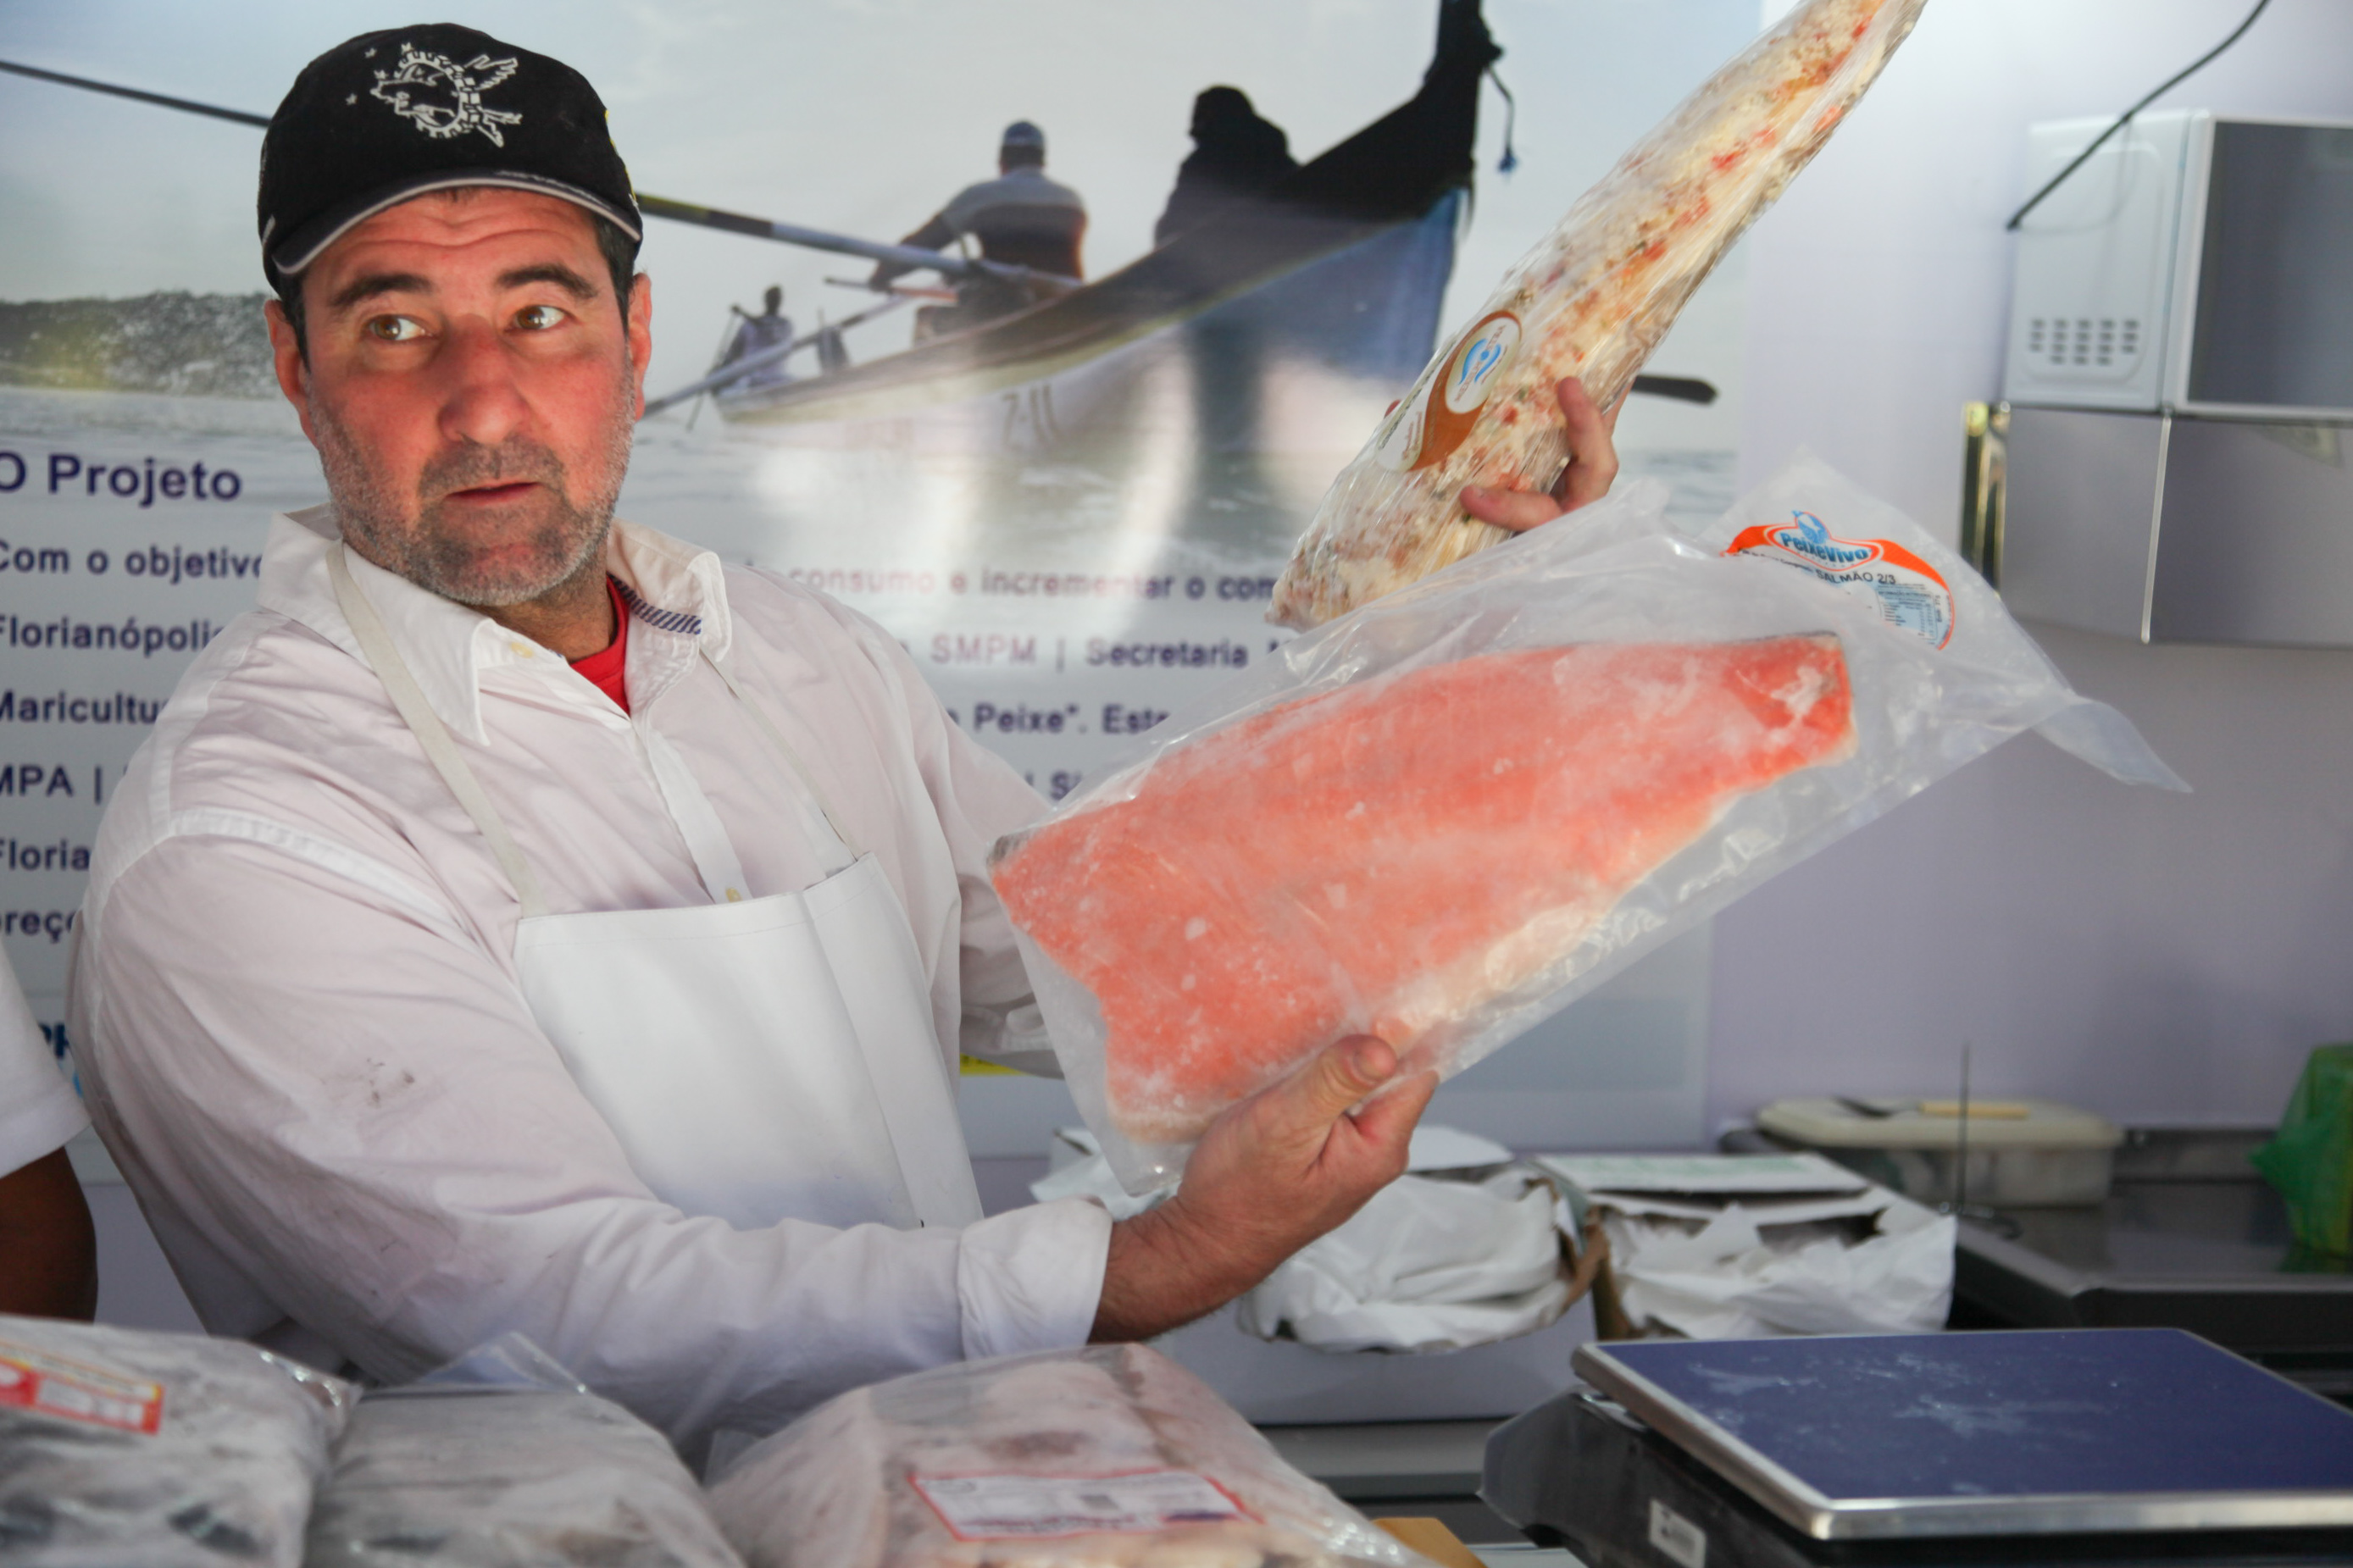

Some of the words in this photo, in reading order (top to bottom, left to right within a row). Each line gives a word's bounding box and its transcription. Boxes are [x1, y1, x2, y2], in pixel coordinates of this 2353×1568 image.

[0, 450, 27, 493] O
[47, 453, 242, 508] Projeto
[86, 550, 109, 575] o
[1815, 568, 1873, 584] SALMÃO
[950, 570, 967, 594] e
[981, 568, 1174, 600] incrementar
[1186, 575, 1206, 601] o
[932, 634, 1036, 666] SMPM
[1086, 637, 1248, 669] Secretaria
[0, 689, 169, 724] aricultu
[0, 837, 90, 871] loria
